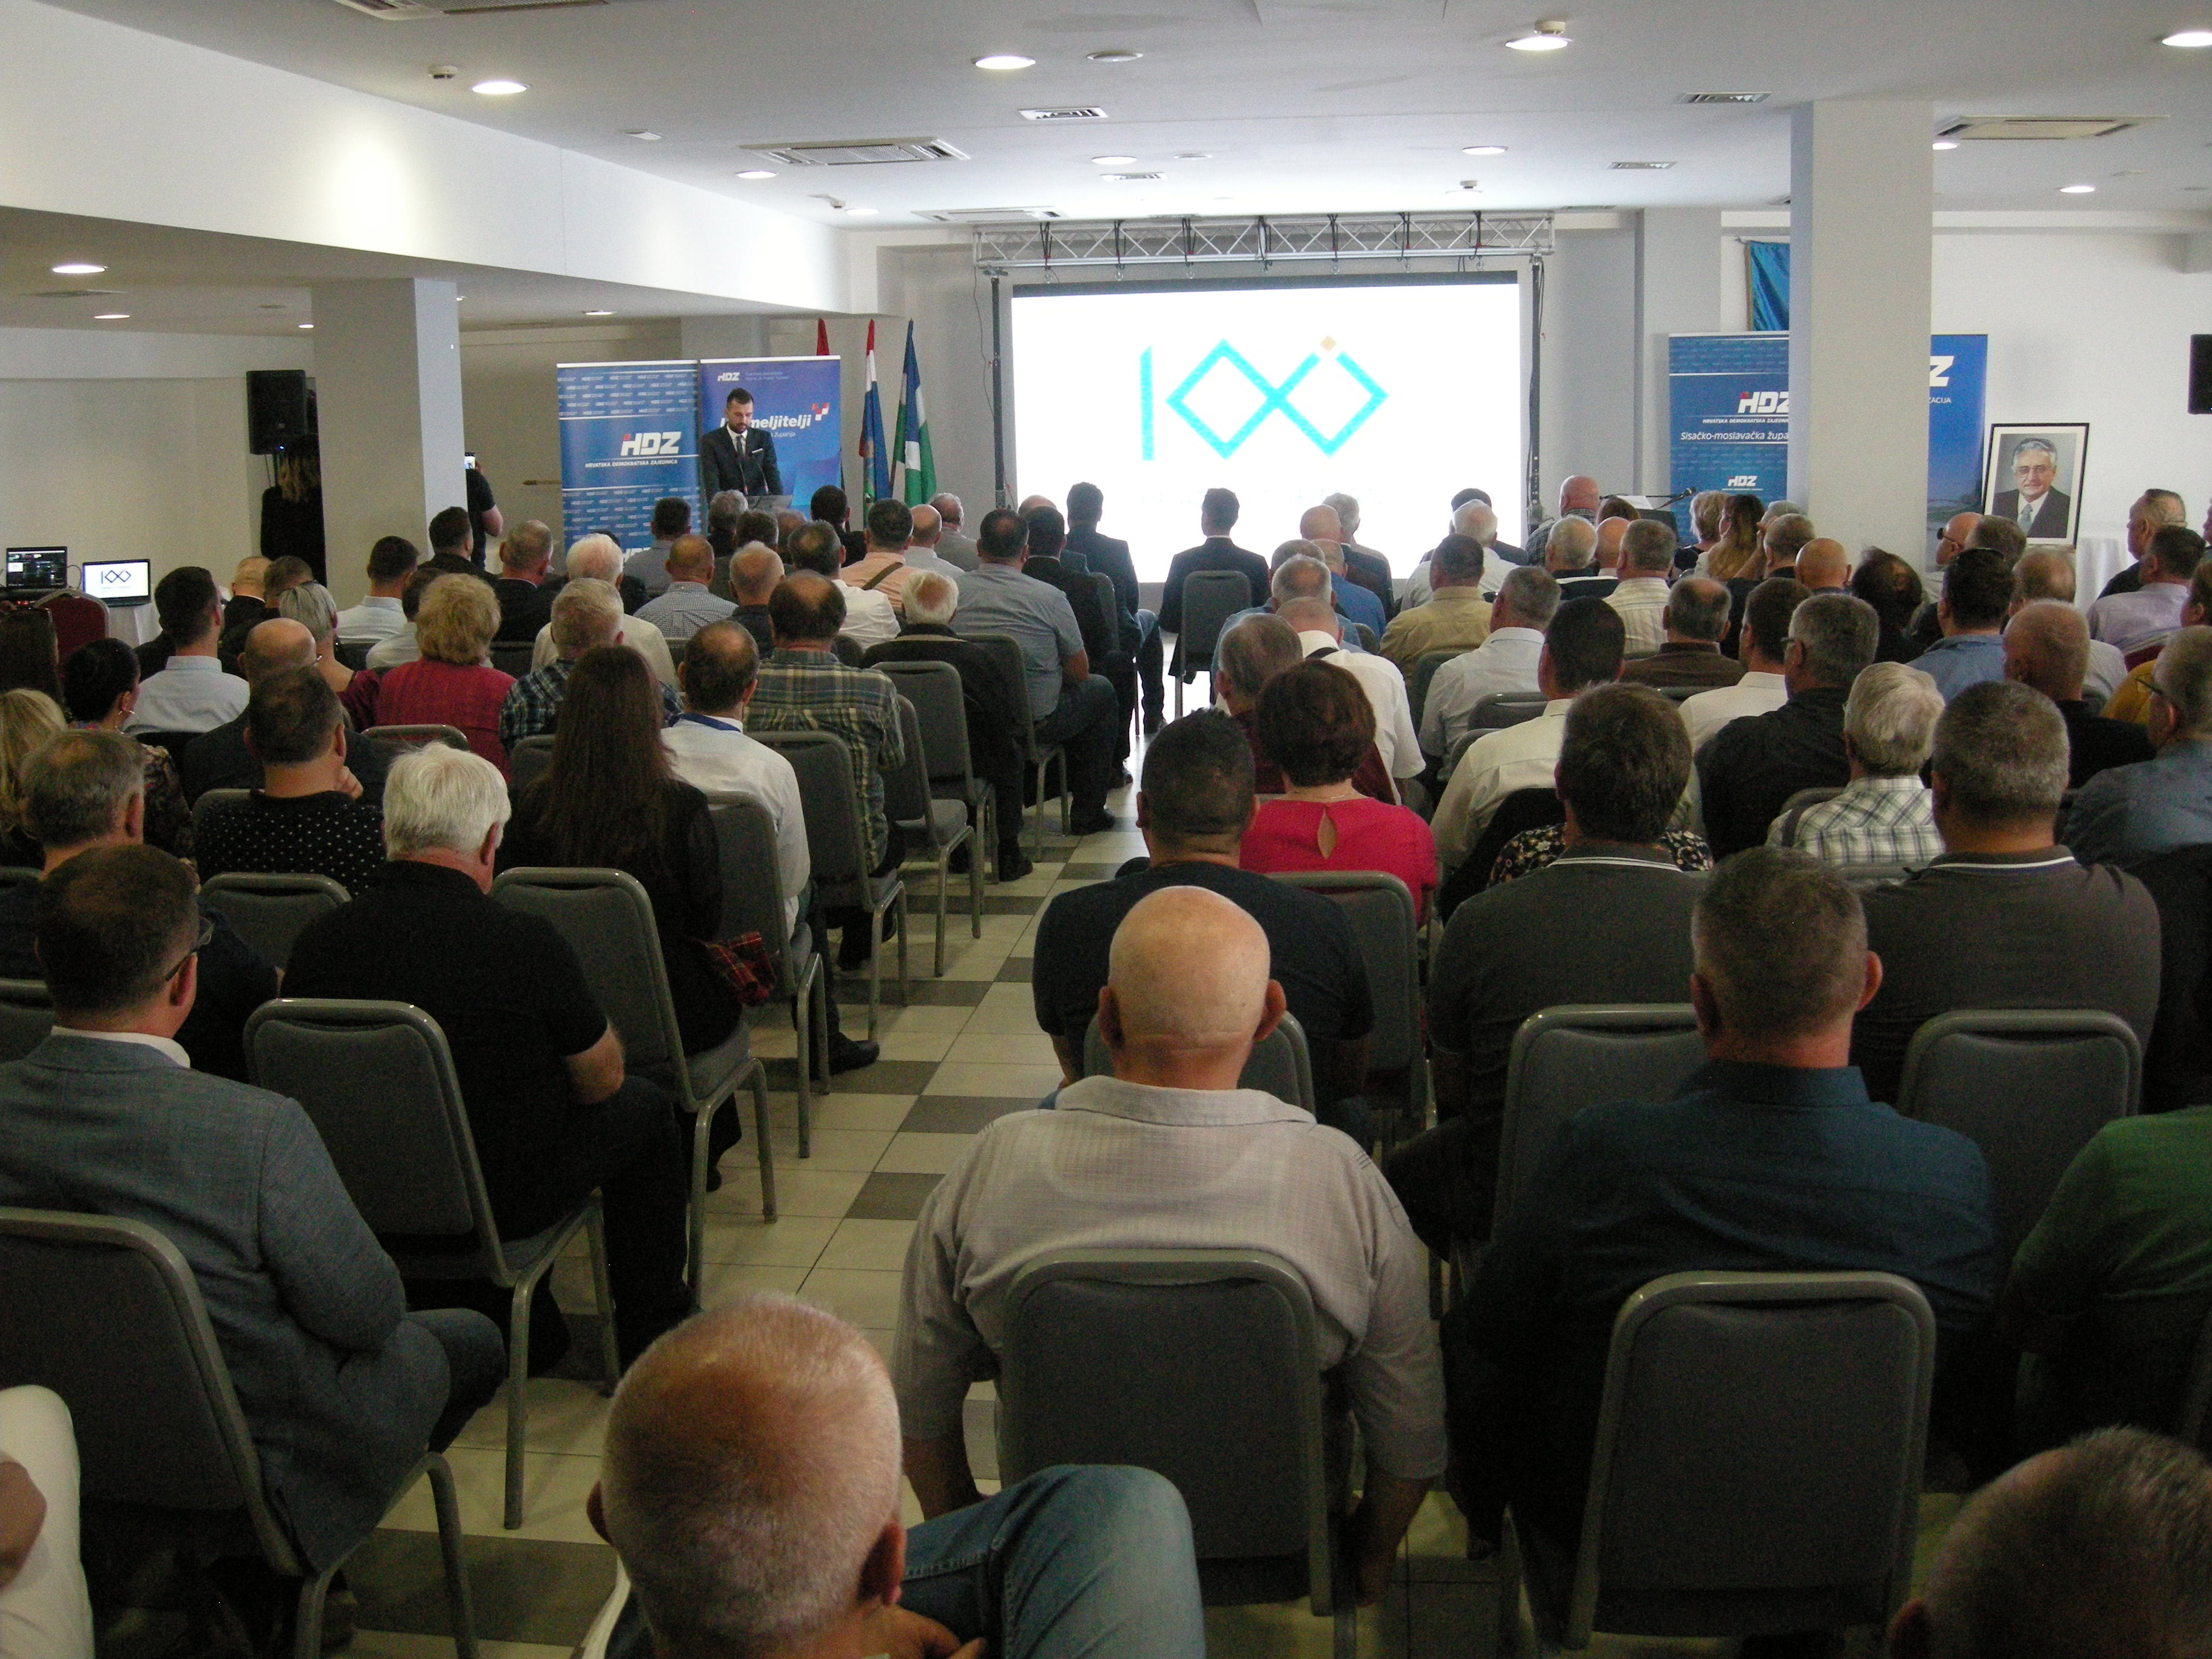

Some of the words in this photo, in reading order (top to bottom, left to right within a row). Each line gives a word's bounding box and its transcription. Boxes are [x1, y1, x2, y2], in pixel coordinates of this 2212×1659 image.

[717, 372, 740, 381] HDZ
[720, 414, 812, 431] meljitelji
[1680, 431, 1765, 440] Sisačko-moslavačka
[1767, 431, 1789, 441] župa
[620, 431, 682, 456] HDZ
[1728, 475, 1758, 487] HDZ
